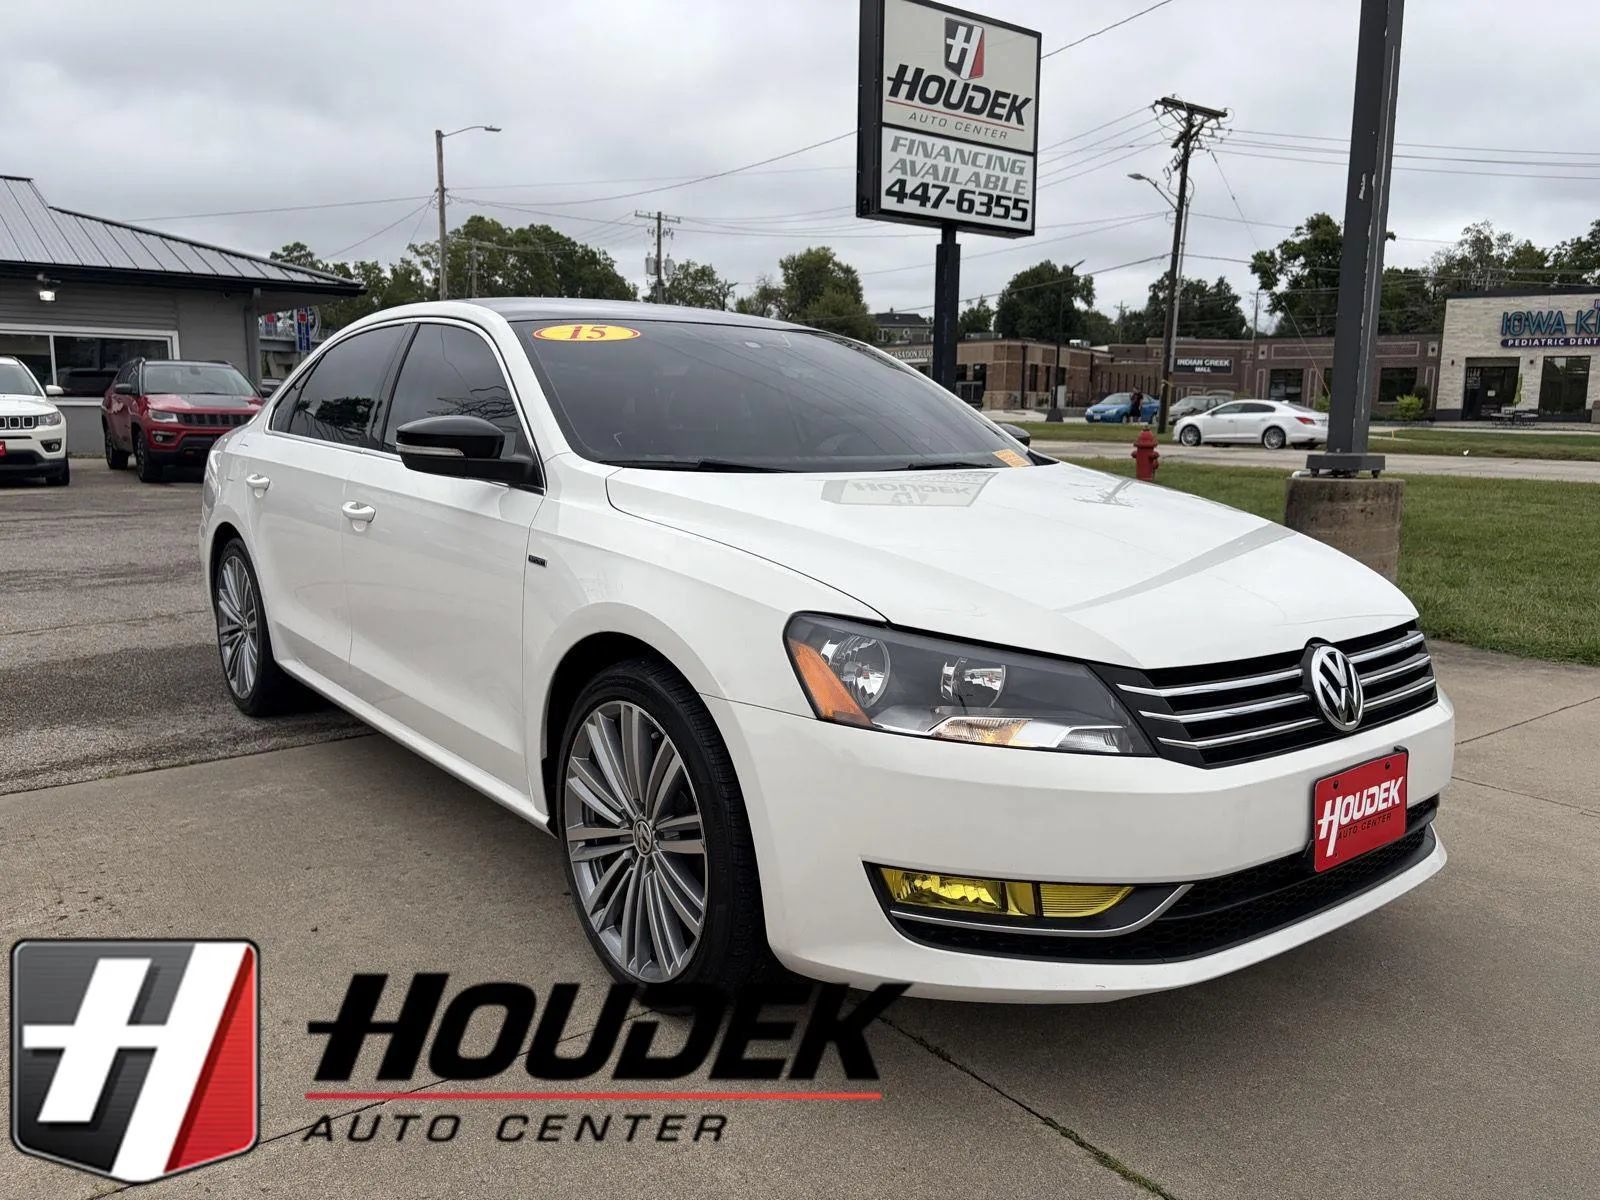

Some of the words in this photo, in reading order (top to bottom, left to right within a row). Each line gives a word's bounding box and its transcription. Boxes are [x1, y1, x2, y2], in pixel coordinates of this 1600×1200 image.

[887, 64, 1032, 126] HOUDEK
[909, 112, 947, 127] AUTO
[955, 121, 1008, 140] CENTER
[890, 136, 1026, 175] FINANCING
[888, 158, 1028, 196] AVAILABLE
[885, 178, 1029, 222] 447-6355
[569, 326, 608, 340] 15
[1501, 310, 1567, 336] IOWA
[1508, 338, 1565, 347] PEDIATRIC
[1204, 359, 1231, 367] CREEK
[1317, 776, 1404, 858] HOUDEK
[1339, 825, 1358, 840] AUTO
[1361, 814, 1391, 831] CENTER
